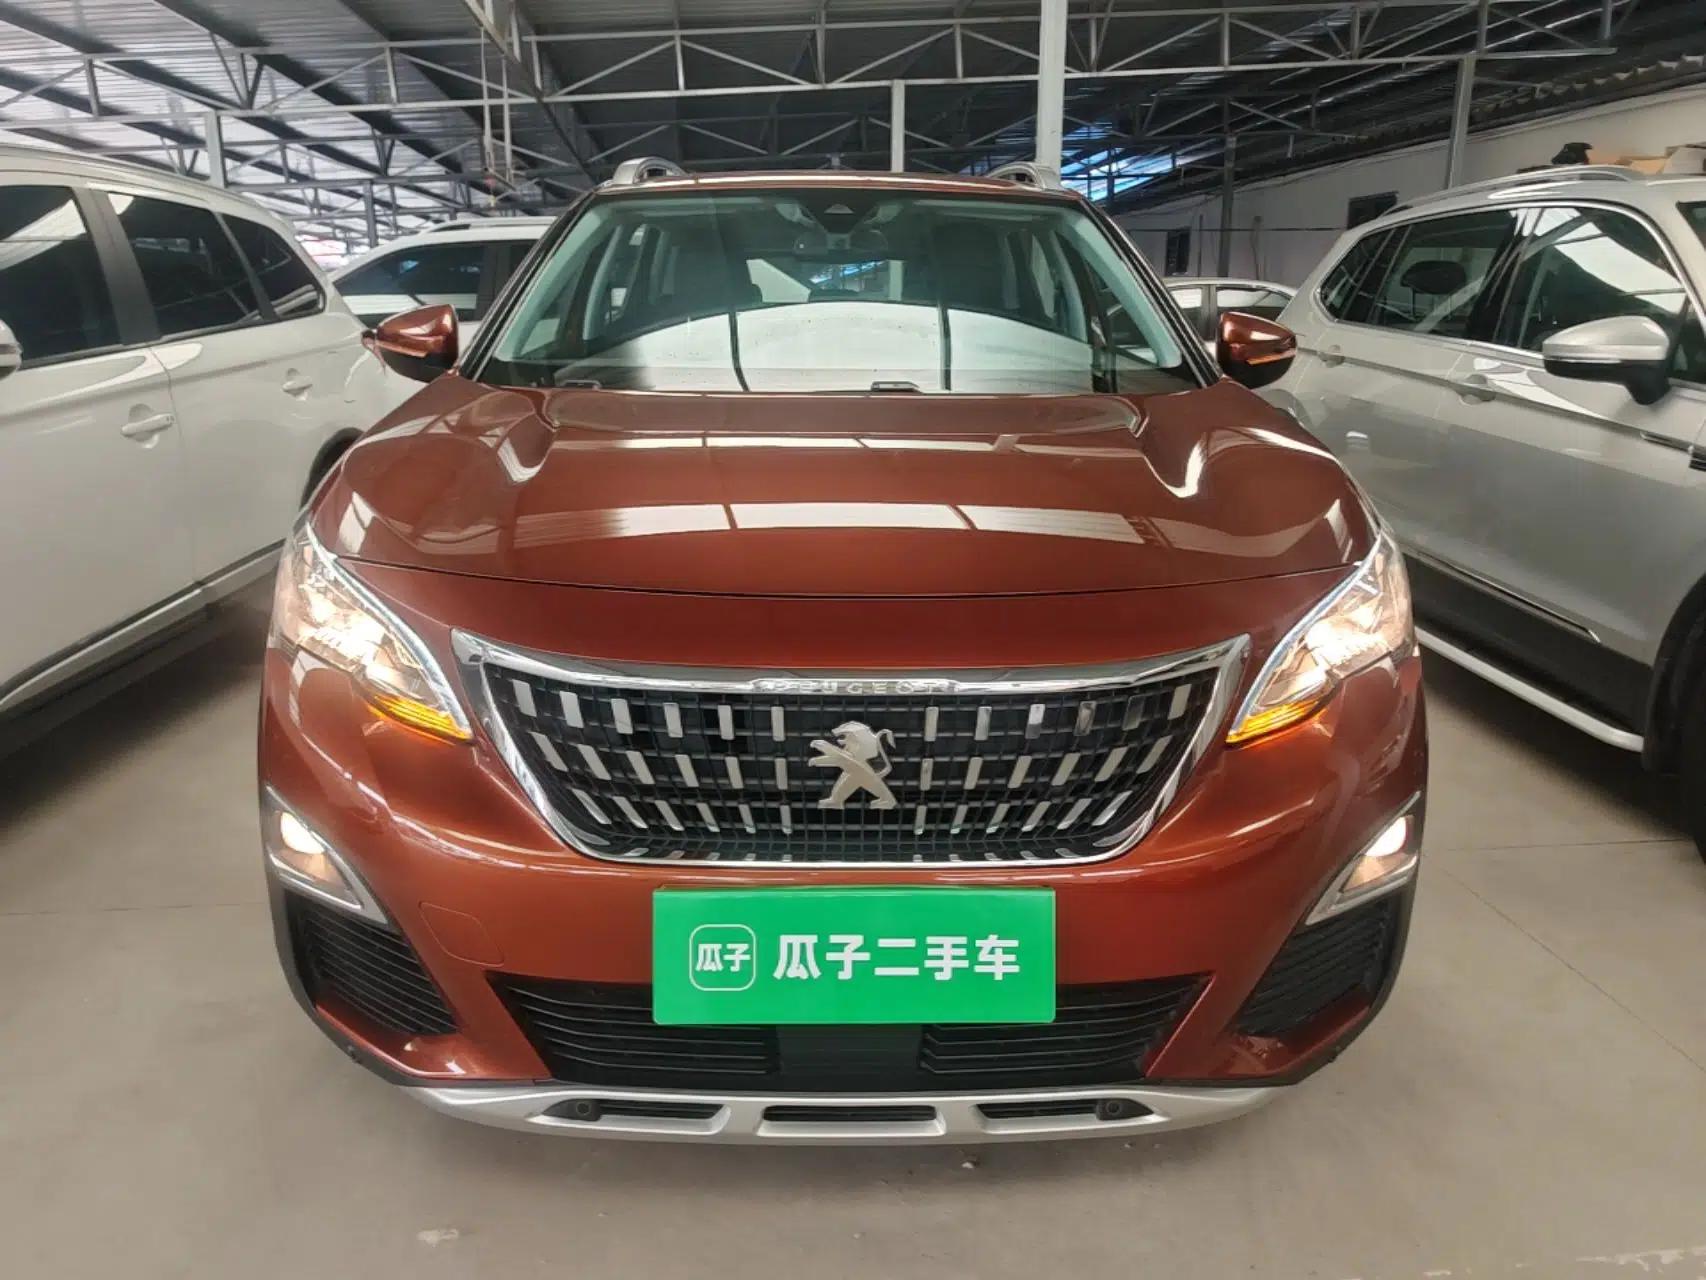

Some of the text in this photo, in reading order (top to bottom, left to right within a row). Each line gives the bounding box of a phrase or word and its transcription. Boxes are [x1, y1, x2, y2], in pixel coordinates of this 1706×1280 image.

[775, 681, 938, 695] PEUGEOT
[695, 943, 751, 972] 瓜子
[773, 934, 1020, 980] 瓜子二手车
